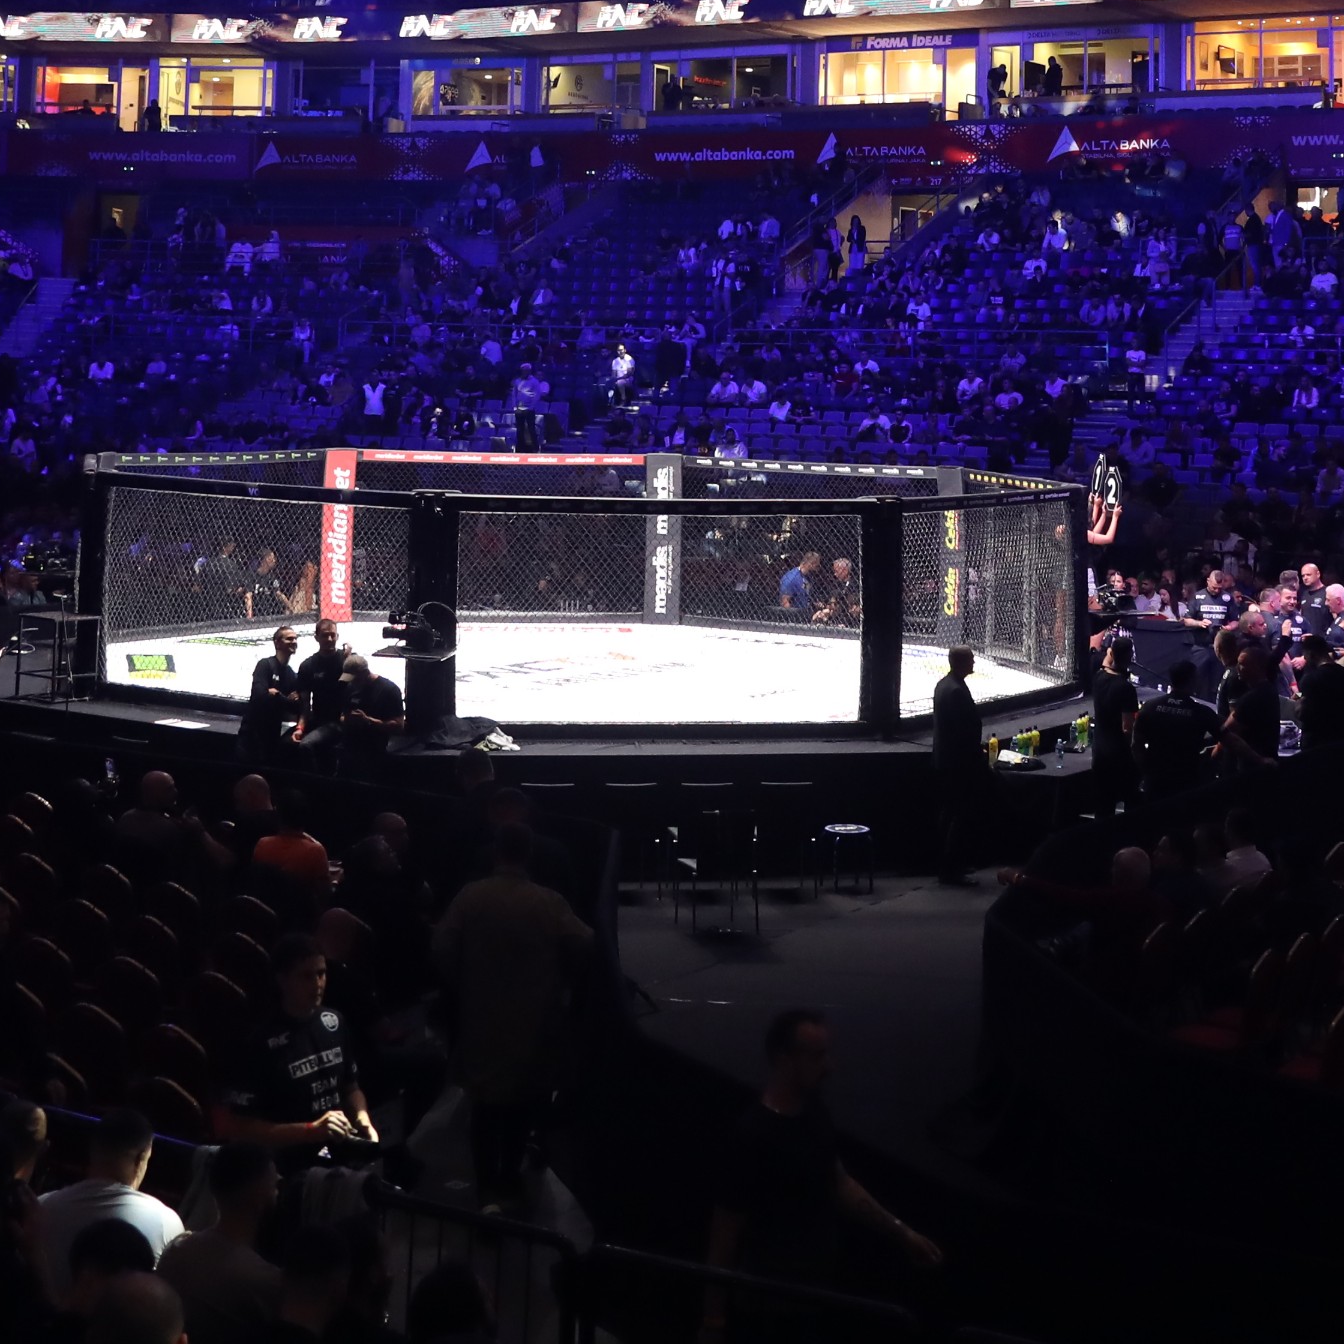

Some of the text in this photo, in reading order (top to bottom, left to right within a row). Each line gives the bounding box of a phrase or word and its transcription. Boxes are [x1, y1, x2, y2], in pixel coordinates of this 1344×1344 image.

[399, 13, 456, 39] FNC
[510, 8, 563, 34] FNC
[597, 2, 651, 29] FNC
[94, 16, 153, 40] FNC
[192, 17, 249, 41] FNC
[293, 16, 349, 40] FNC
[866, 34, 953, 50] FORMA IDEALE
[655, 147, 795, 164] www.altabanka.com
[846, 145, 927, 158] ALTABANKA
[1080, 137, 1171, 152] ALTABANKA
[89, 149, 238, 165] www.altabanka.com
[282, 154, 358, 164] ALTABANKA
[930, 177, 943, 186] 217
[1094, 465, 1101, 490] 1
[1107, 478, 1116, 504] 2
[328, 467, 351, 605] meridianet
[311, 1075, 338, 1095] TEAM
